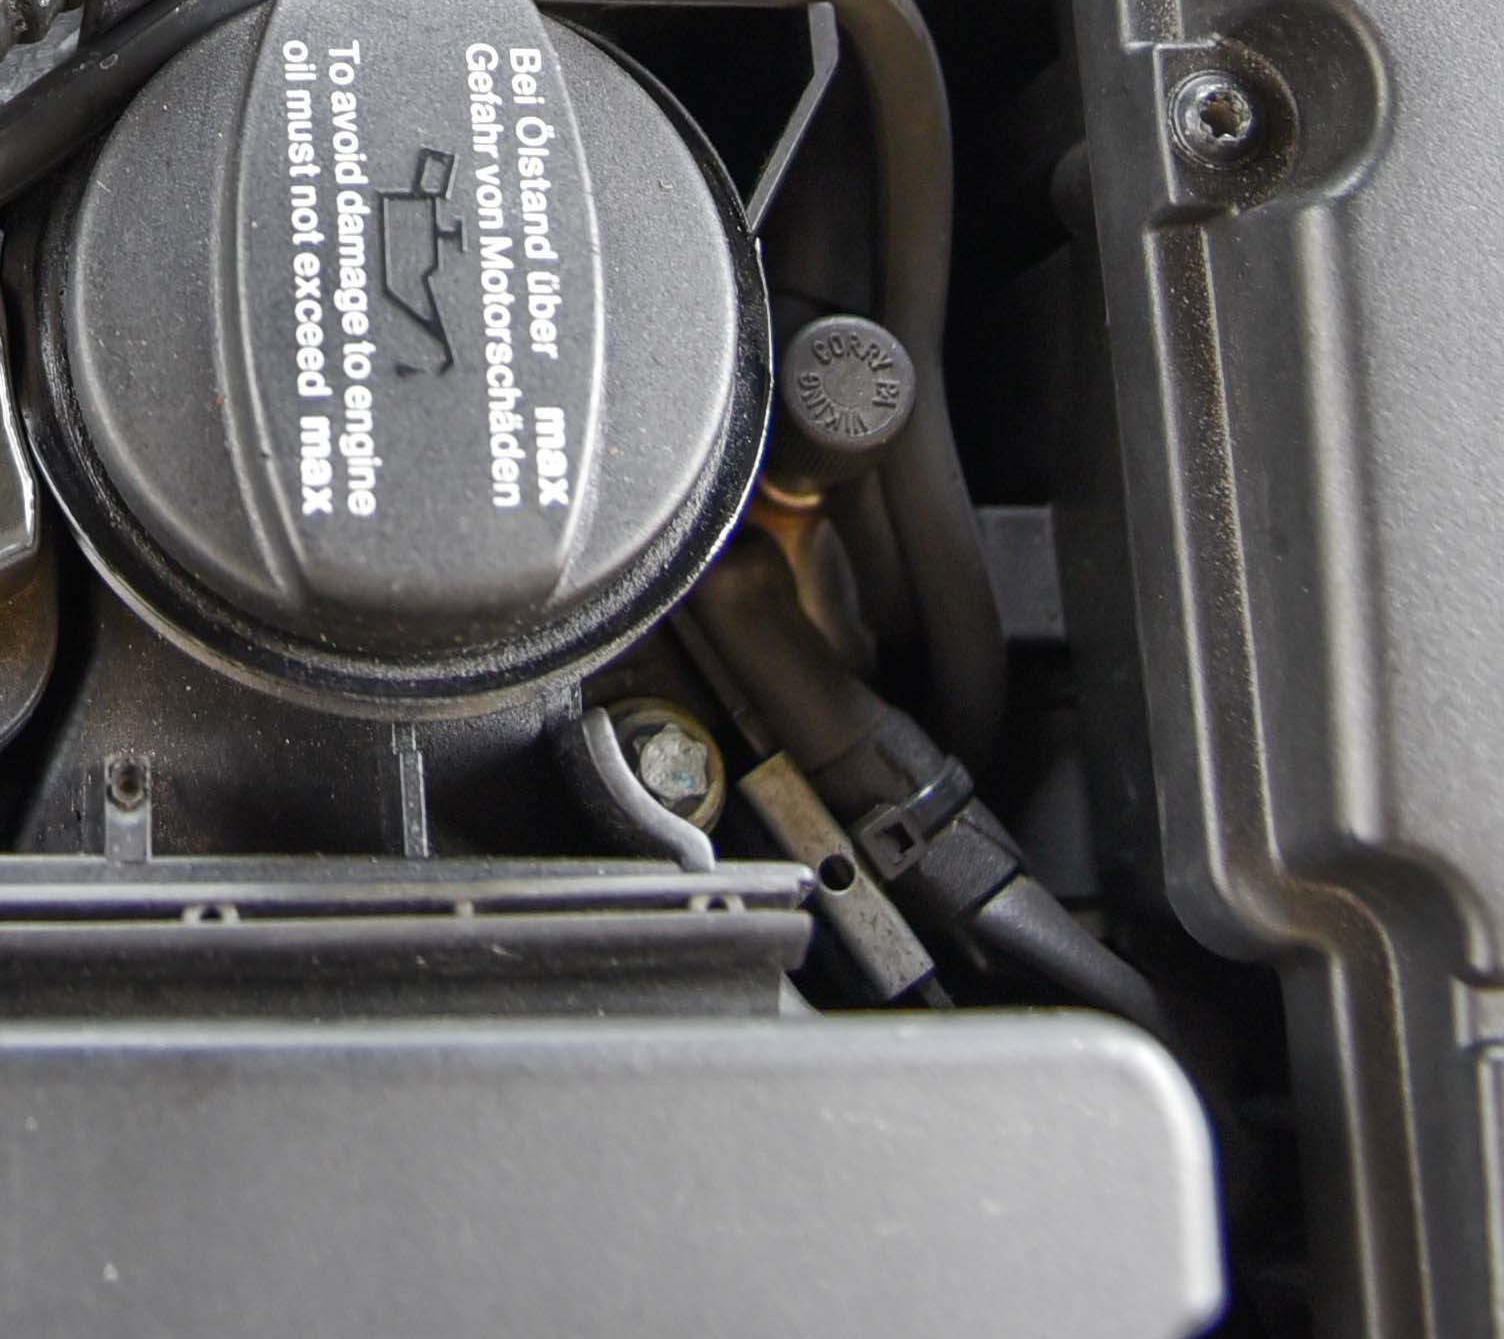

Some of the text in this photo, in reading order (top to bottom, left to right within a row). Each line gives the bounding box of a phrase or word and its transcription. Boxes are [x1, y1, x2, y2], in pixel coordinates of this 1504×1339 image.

[282, 39, 333, 516] oil must not exceed max
[328, 39, 383, 516] To avoid damage to engine
[465, 42, 526, 507] Gefahr von Motorschäden
[509, 48, 569, 507] Bei Ölstand über max
[811, 331, 892, 372] CORRY
